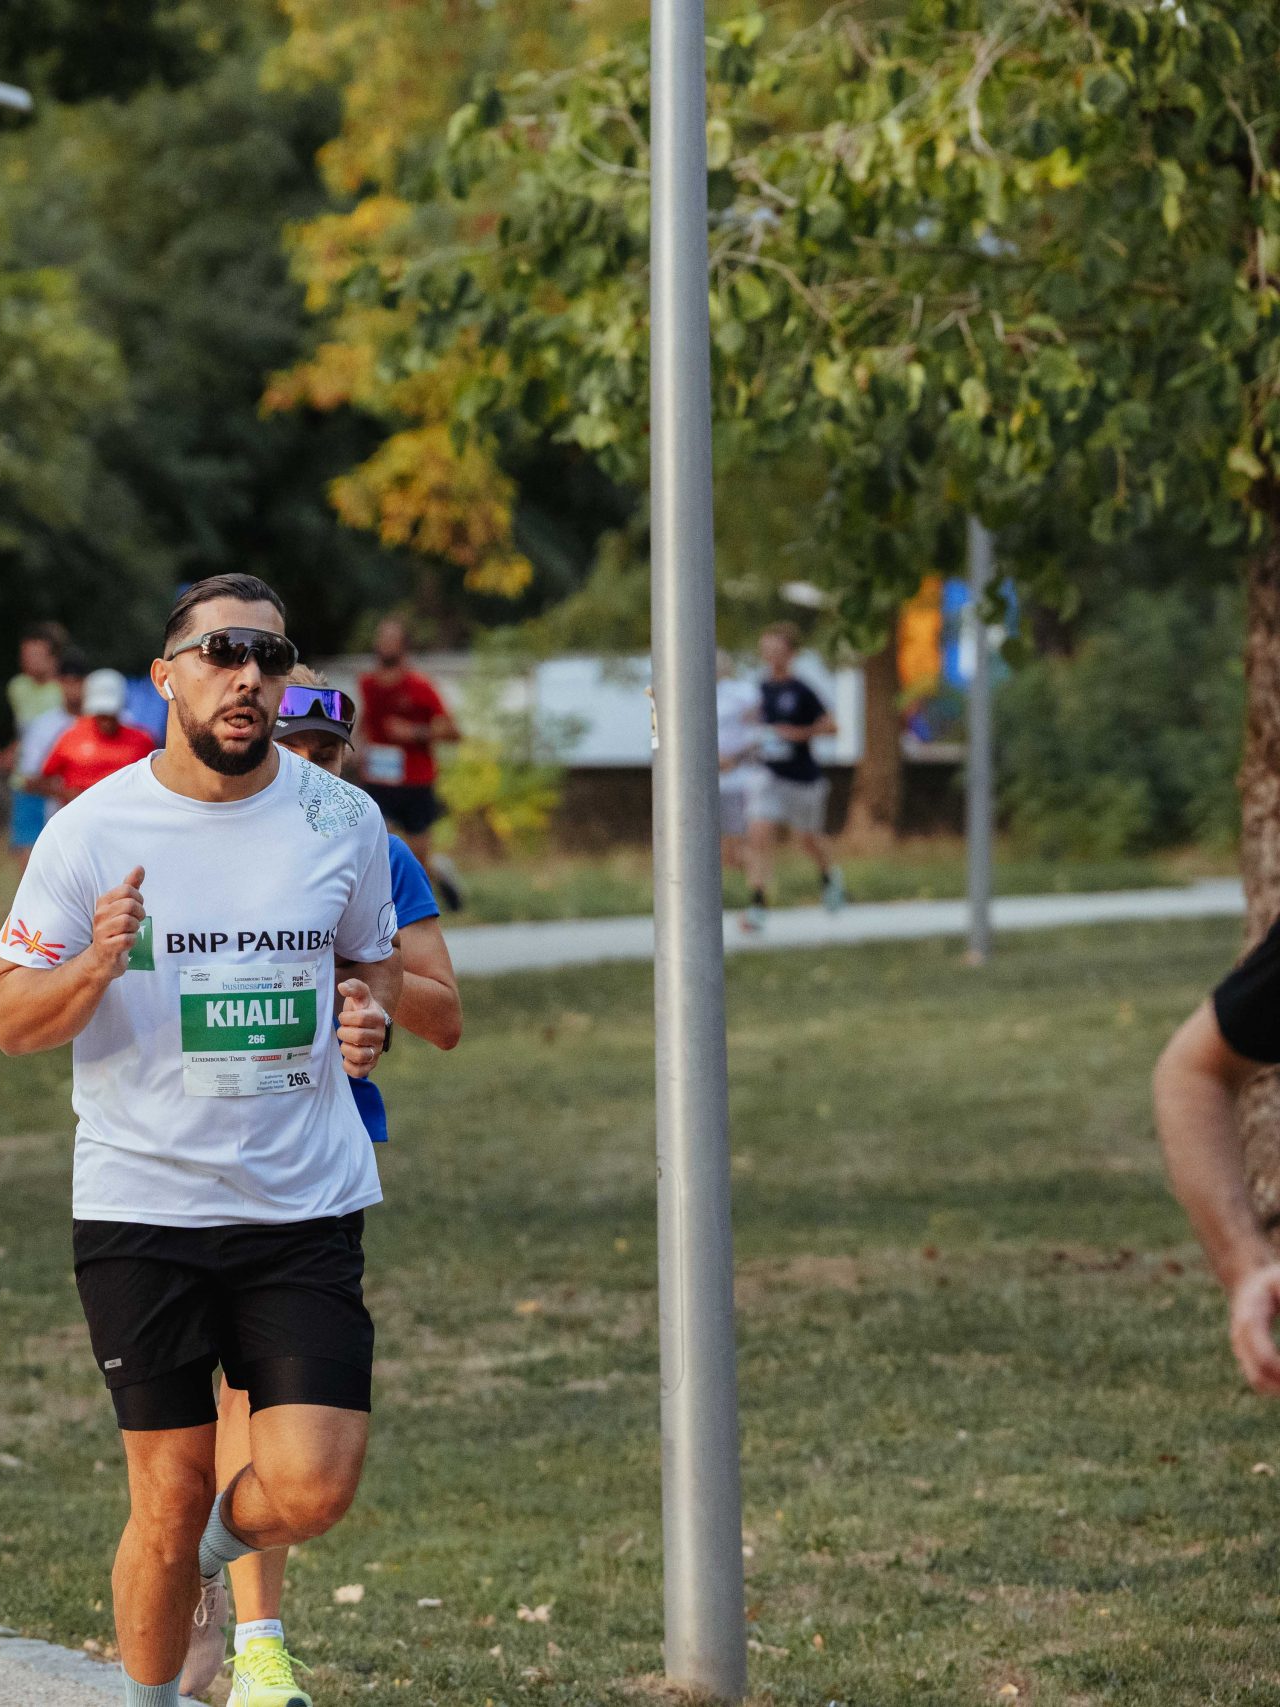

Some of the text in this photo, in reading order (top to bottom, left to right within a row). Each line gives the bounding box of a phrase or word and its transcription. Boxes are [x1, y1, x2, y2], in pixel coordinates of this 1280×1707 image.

[315, 773, 358, 828] DELEGATION
[166, 932, 229, 954] BNP
[206, 998, 300, 1028] KHALIL
[247, 1034, 266, 1045] 266
[287, 1071, 311, 1087] 266
